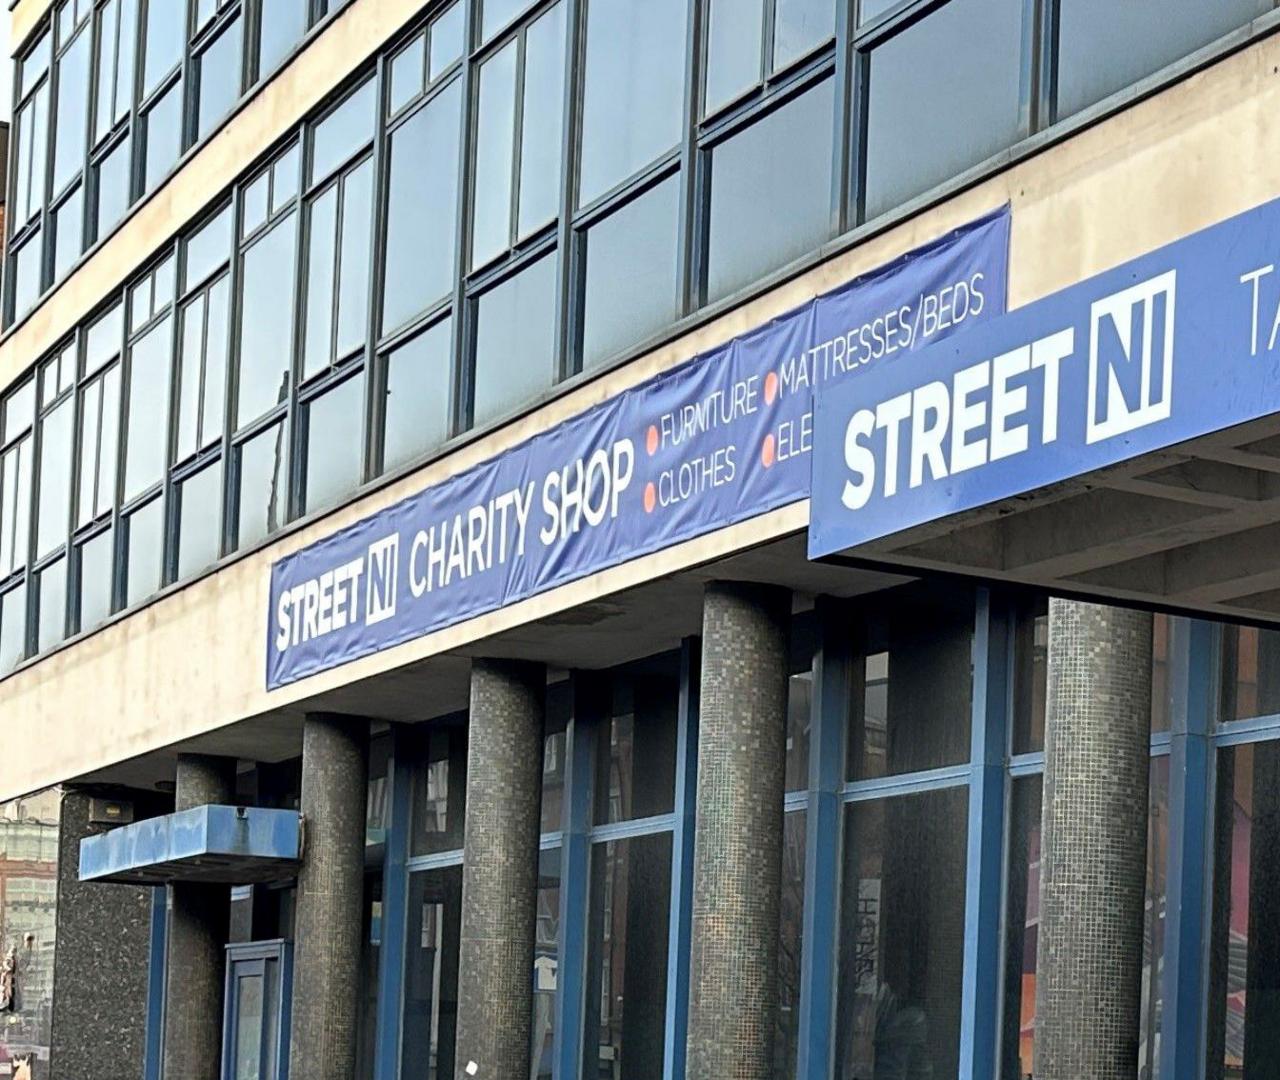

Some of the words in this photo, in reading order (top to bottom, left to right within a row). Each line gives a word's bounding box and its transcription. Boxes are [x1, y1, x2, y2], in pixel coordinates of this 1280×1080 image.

[660, 375, 760, 450] FURNITURE
[779, 272, 984, 399] MATTRESSES/BEDS
[841, 326, 1075, 510] STREET
[1091, 279, 1172, 436] NI
[276, 556, 364, 653] STREET
[367, 537, 397, 621] NI
[408, 480, 535, 598] CHARITY
[540, 438, 635, 546] SHOP
[658, 445, 736, 507] CLOTHES
